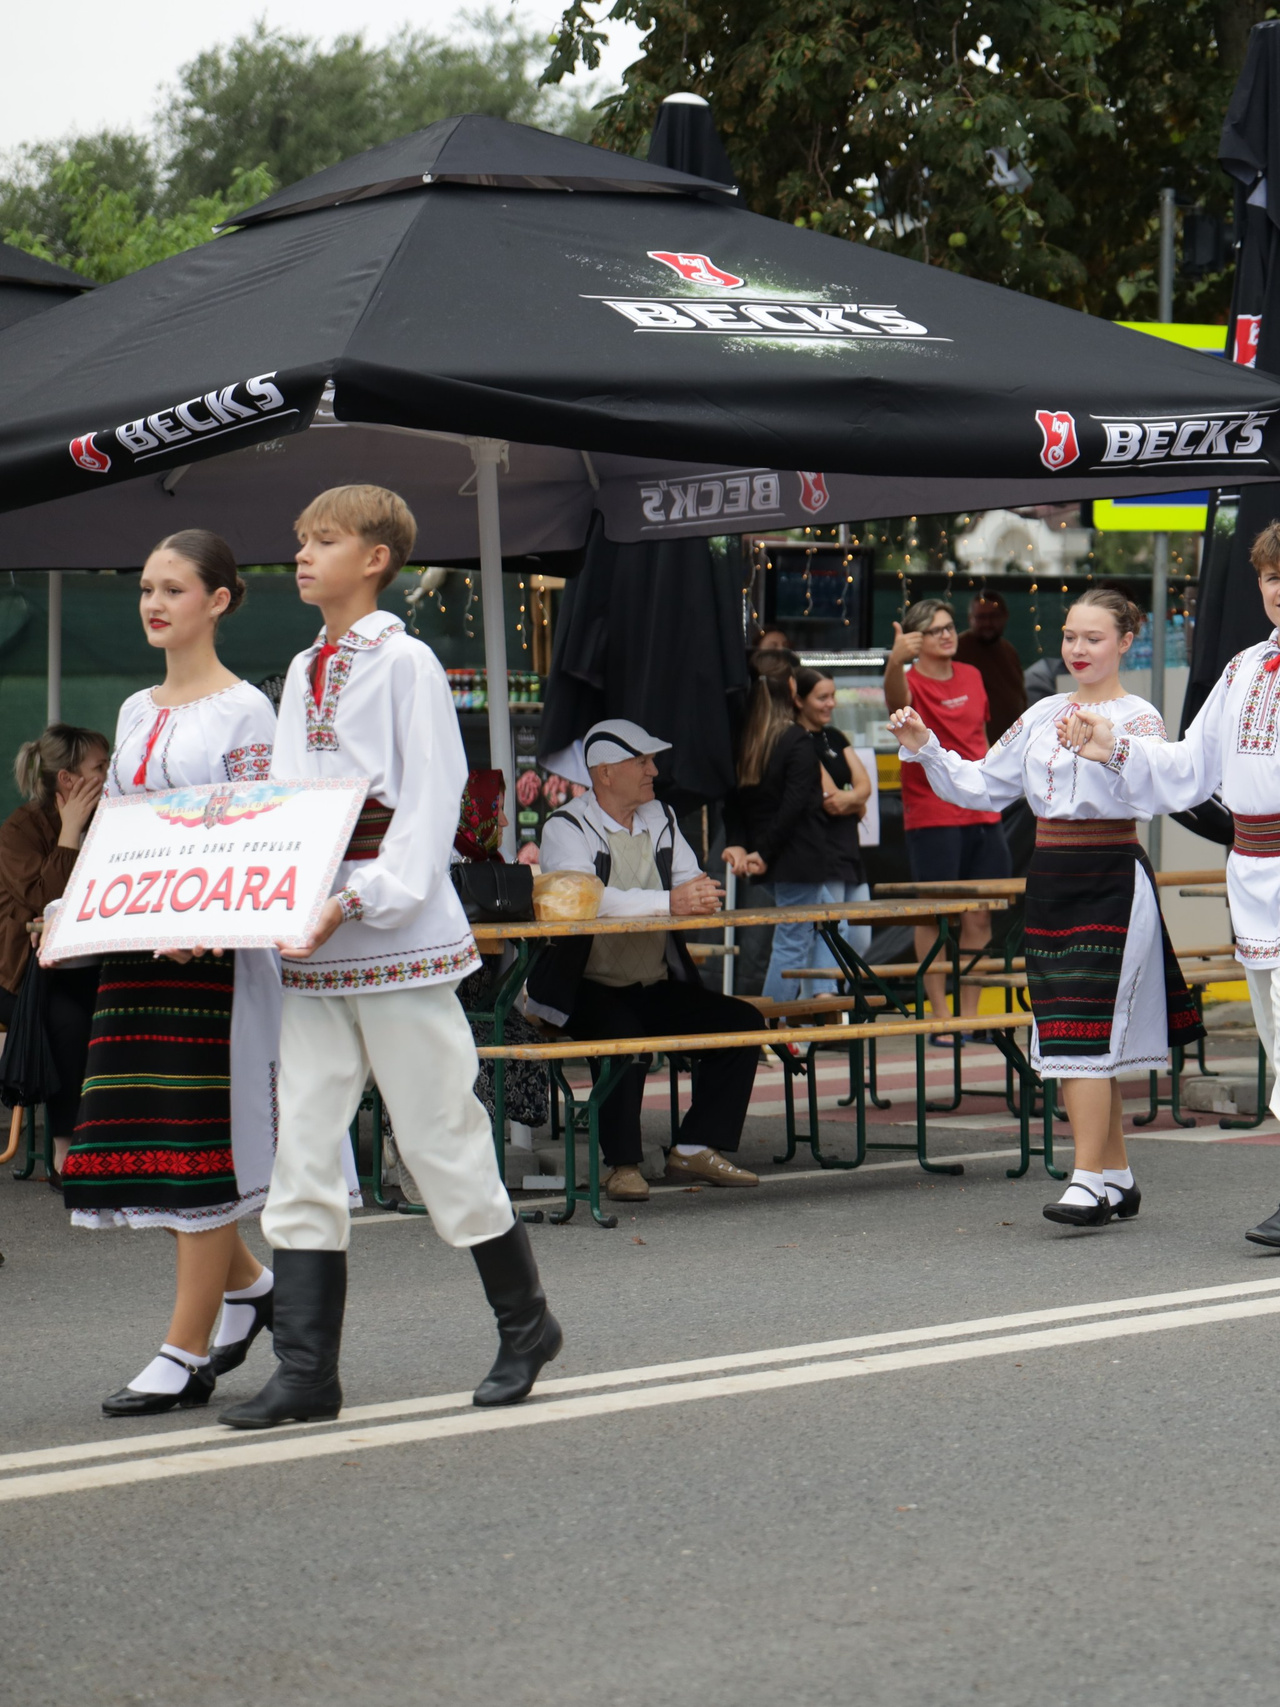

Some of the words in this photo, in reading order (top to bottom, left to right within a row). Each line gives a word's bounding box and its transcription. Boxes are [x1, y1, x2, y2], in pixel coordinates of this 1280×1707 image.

[602, 301, 929, 335] BECK'S
[115, 371, 285, 454] BECKS
[1101, 411, 1270, 463] BECK'S
[179, 844, 196, 855] DE
[202, 842, 235, 854] DANS
[242, 840, 302, 852] POPULAR
[76, 865, 298, 922] LOZIOARA
